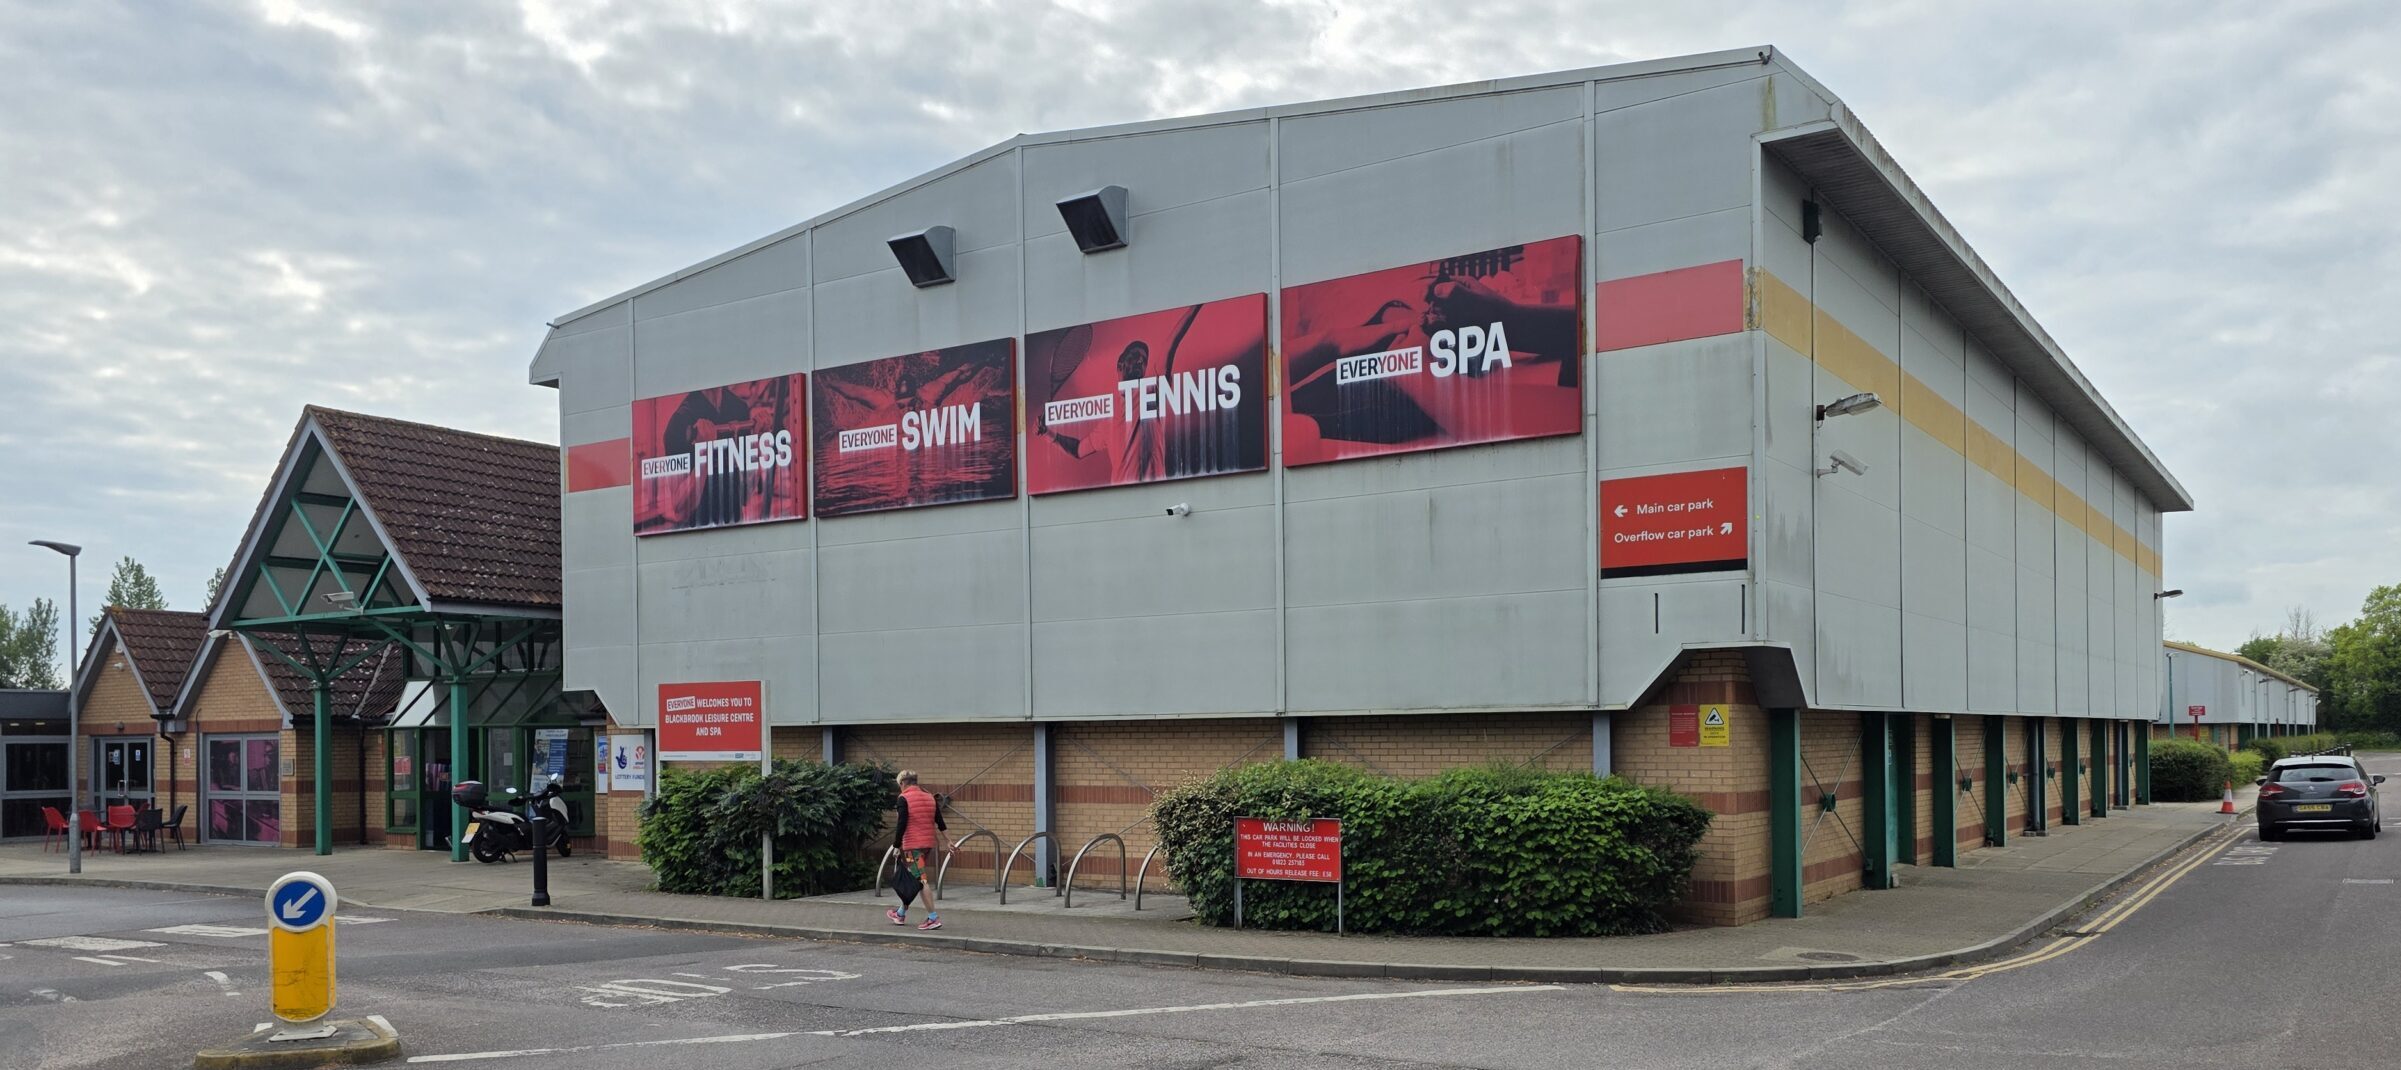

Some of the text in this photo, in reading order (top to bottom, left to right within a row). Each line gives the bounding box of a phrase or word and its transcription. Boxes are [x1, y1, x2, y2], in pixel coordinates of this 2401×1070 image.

[1339, 321, 1513, 380] EVERYONE SPA
[1048, 364, 1241, 423] EVERYONE TENNIS
[841, 401, 981, 451] EVERYONE SWIM
[643, 429, 792, 478] EVERYONE FITNESS
[1636, 498, 1714, 515] Main car park
[1614, 525, 1714, 543] Overflow car park
[667, 697, 752, 710] EVERYONE WELCOMES YOU TO
[665, 712, 754, 724] BLACKBROOK LEISURE CENTRE
[695, 726, 722, 736] AND SPA
[1272, 841, 1298, 849] FACILITIES
[1284, 869, 1307, 877] RELEASE
